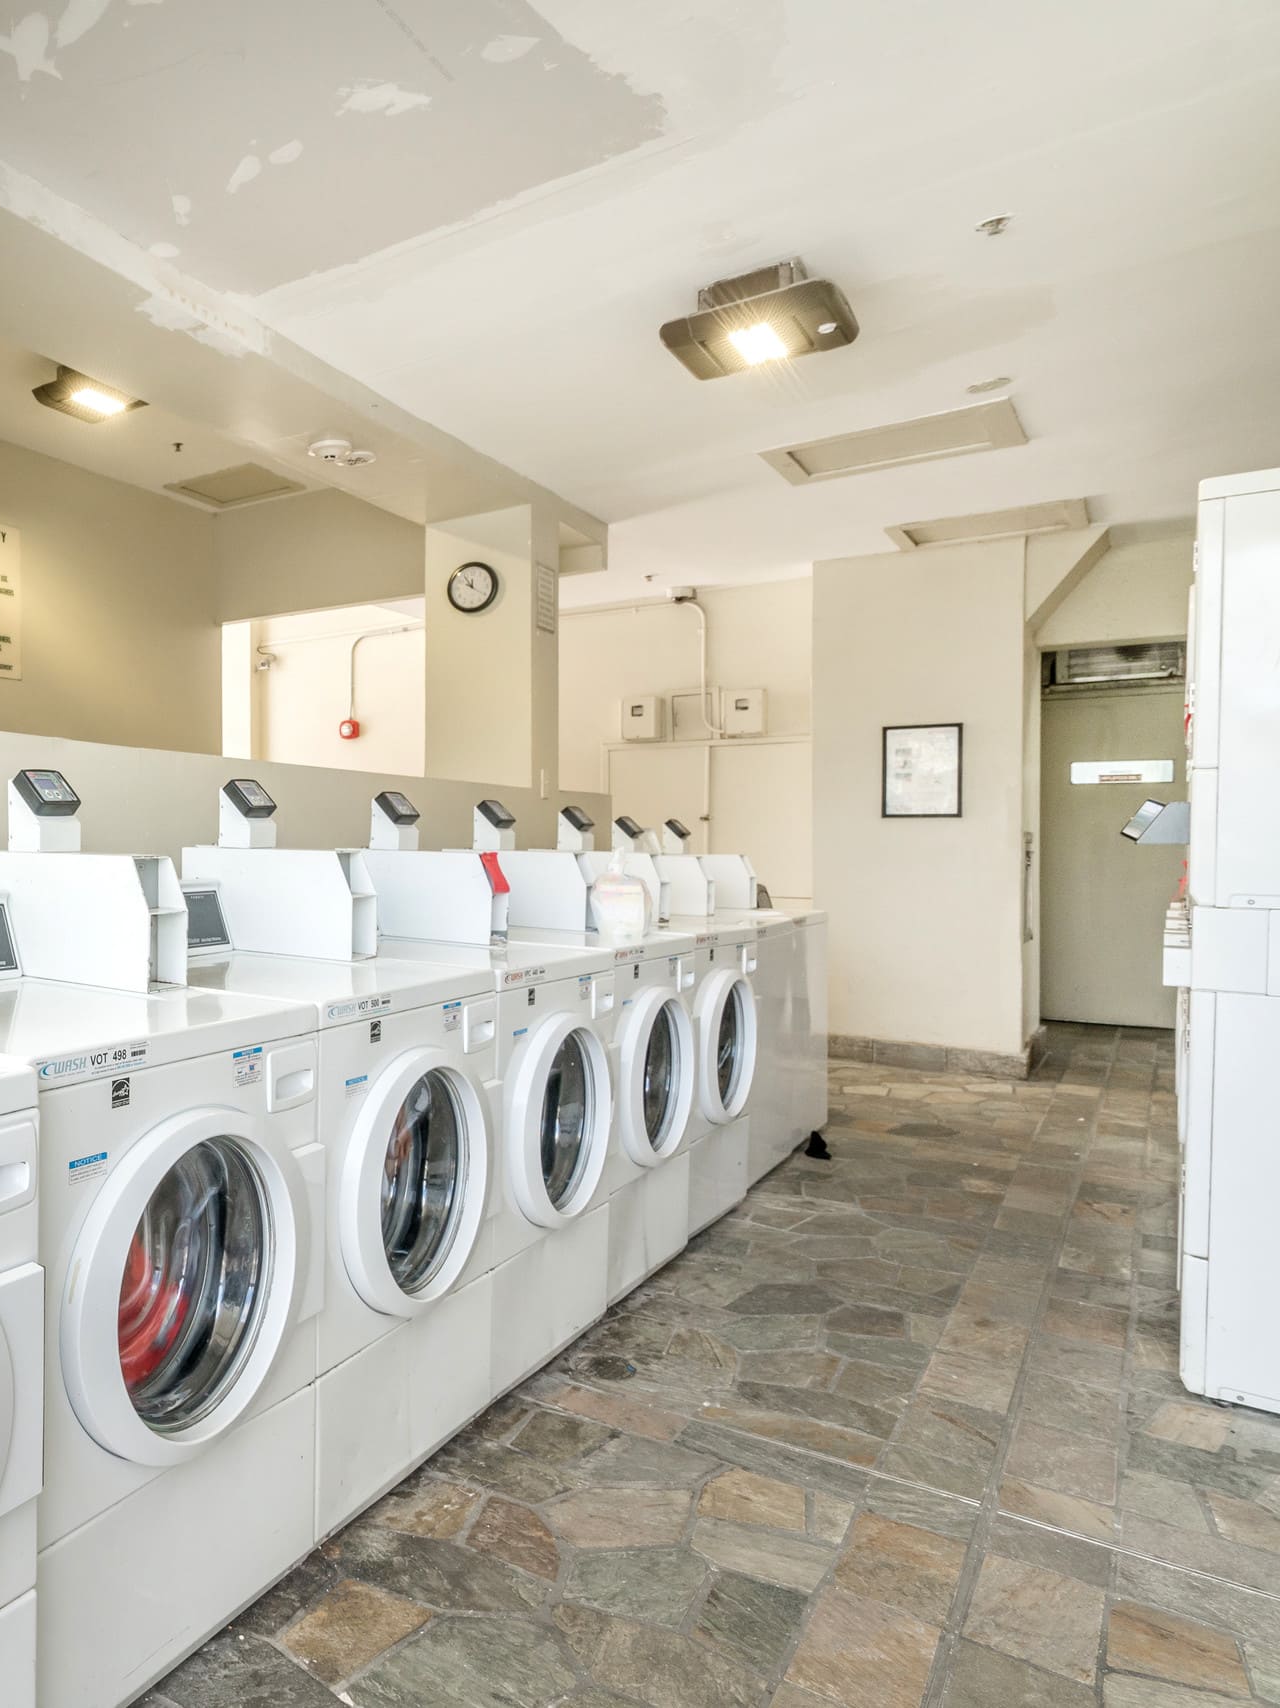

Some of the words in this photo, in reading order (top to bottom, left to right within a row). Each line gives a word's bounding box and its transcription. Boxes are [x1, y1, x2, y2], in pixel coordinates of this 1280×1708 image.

[358, 1000, 368, 1010] VOT
[90, 1053, 108, 1066] VOT
[113, 1049, 127, 1061] 498
